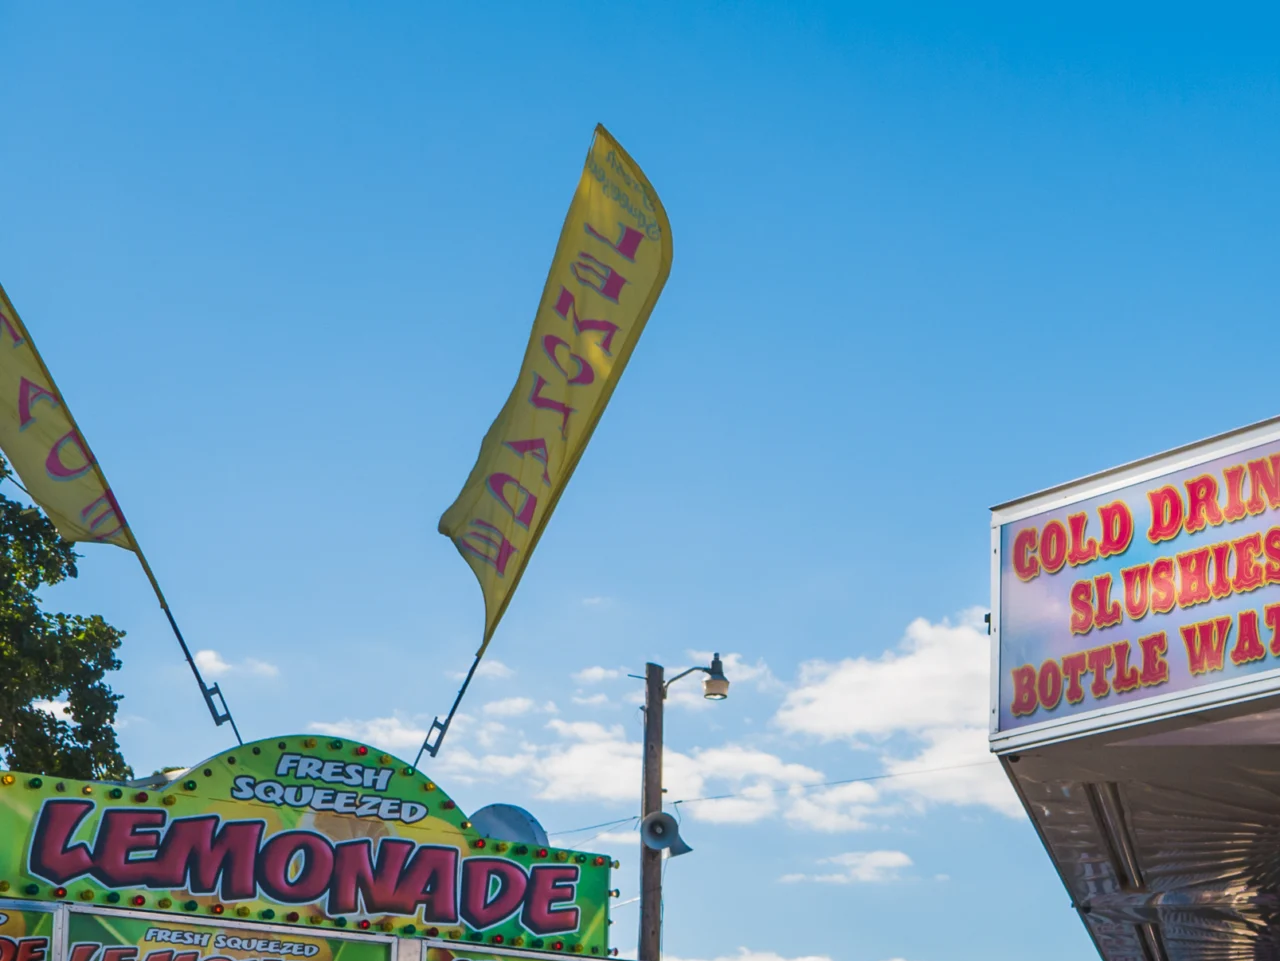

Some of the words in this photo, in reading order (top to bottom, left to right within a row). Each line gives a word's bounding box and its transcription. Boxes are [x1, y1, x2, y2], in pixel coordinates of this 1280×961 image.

[1012, 499, 1134, 581] COLD
[1010, 631, 1169, 718] BOTTLE
[231, 775, 429, 824] SQUEEZED
[276, 753, 395, 791] FRESH
[29, 797, 582, 936] LEMONADE
[145, 927, 209, 946] FRESH
[215, 934, 319, 957] SQUEEZED
